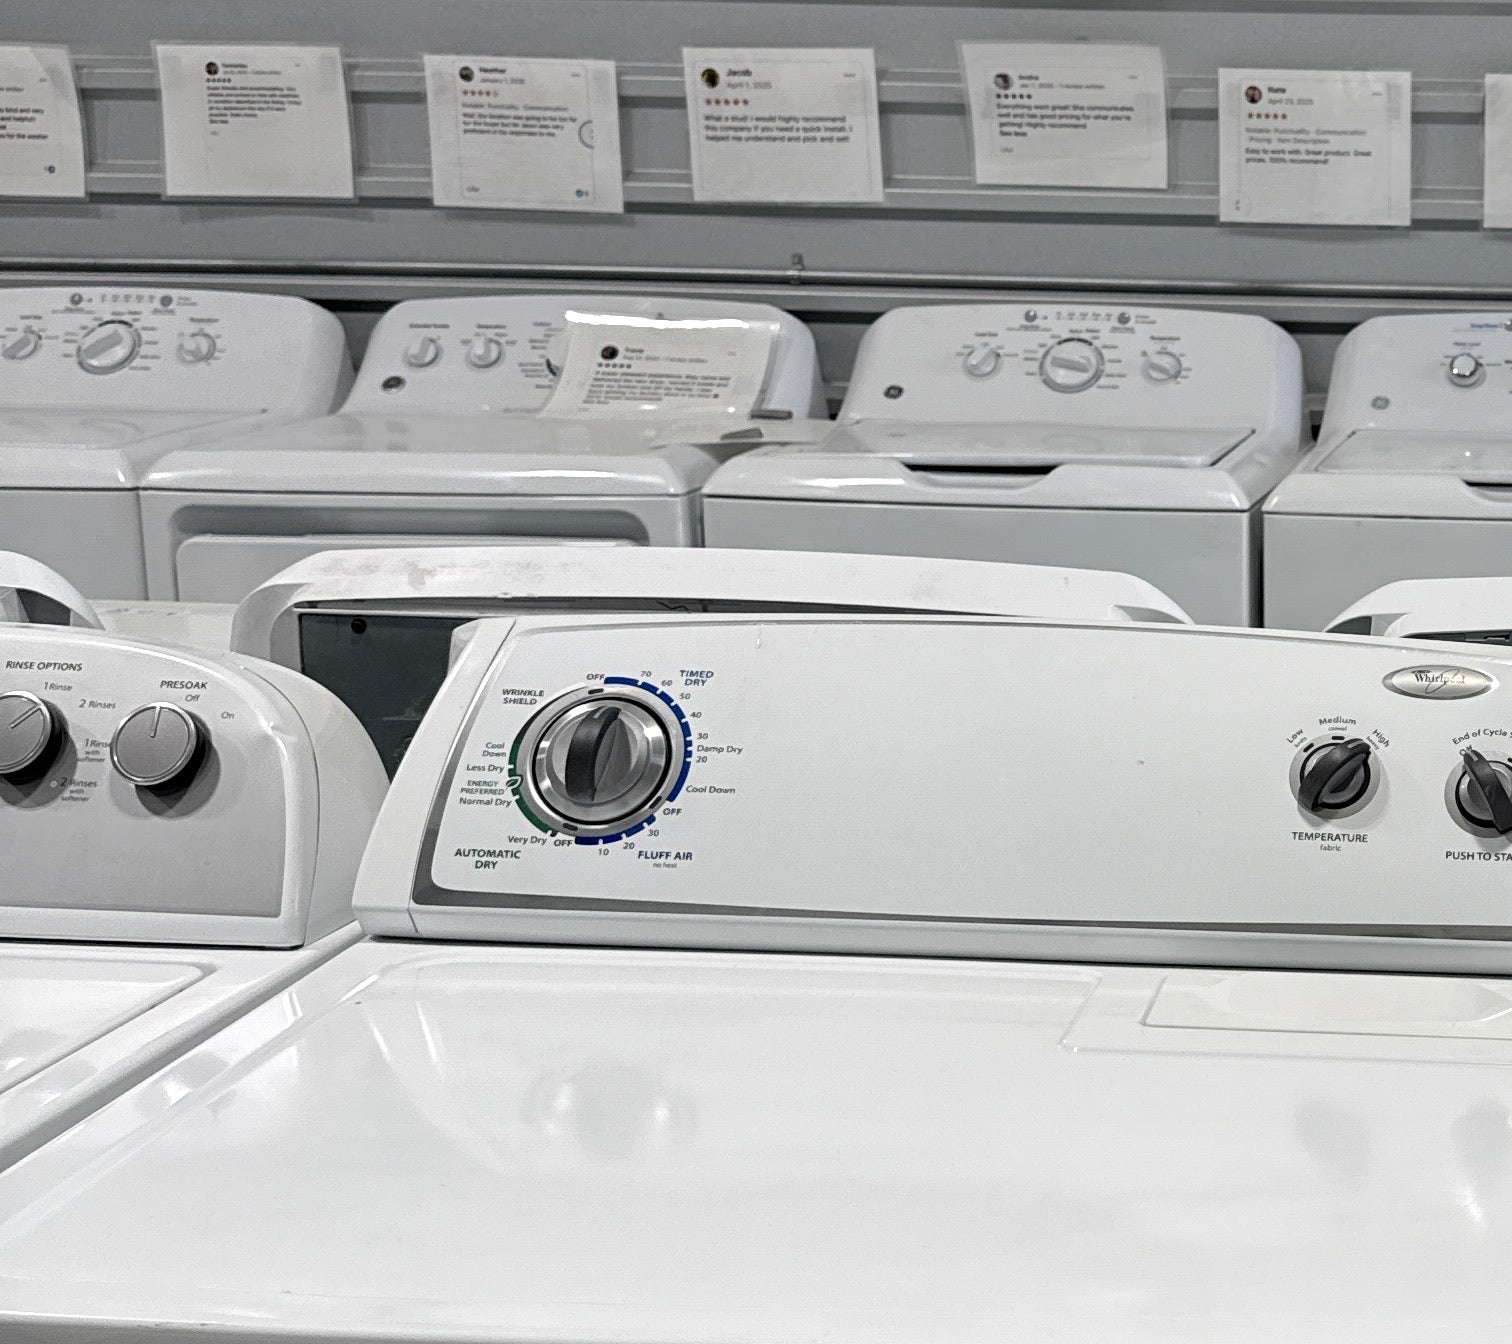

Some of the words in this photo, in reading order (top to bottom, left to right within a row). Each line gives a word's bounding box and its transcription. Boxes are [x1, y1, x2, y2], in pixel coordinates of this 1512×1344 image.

[6, 661, 35, 670] RINSE
[37, 662, 83, 671] OPTIONS
[680, 670, 714, 678] TIMED
[684, 679, 708, 687] DRY
[1414, 673, 1466, 685] Whirlpl
[49, 683, 72, 691] Rinse
[160, 680, 208, 689] PRESOAK
[502, 688, 544, 697] WRINKLE
[185, 694, 201, 702] Off
[503, 697, 537, 705] SHIELD
[79, 699, 86, 708] 2
[88, 700, 116, 709] Rinses
[221, 711, 235, 719] On
[1319, 716, 1357, 725] Medium
[1286, 728, 1304, 744] Low
[1372, 728, 1392, 748] High
[1452, 732, 1470, 745] End
[1472, 729, 1481, 737] of
[1483, 728, 1508, 737] Cycle
[696, 745, 724, 754] Damp
[726, 745, 743, 755] Dry
[488, 764, 505, 773] Dry
[60, 777, 67, 787] 2
[69, 779, 97, 788] Rinses
[686, 785, 706, 793] Cool
[709, 786, 736, 794] Down
[459, 797, 493, 805] Normal
[495, 798, 512, 808] Dry
[663, 808, 682, 816] OFF
[648, 829, 660, 837] 30
[1291, 832, 1369, 843] TEMPERATURE
[508, 836, 528, 845] Very
[530, 836, 548, 845] Dry
[554, 839, 573, 847] OFF
[623, 842, 635, 850] 20
[1319, 843, 1342, 852] fabric
[454, 848, 522, 859] AUTOMATIC
[598, 848, 609, 856] 10
[637, 850, 672, 860] FLUFF
[674, 851, 693, 861] AIR
[1445, 851, 1476, 862] PUSH
[1477, 851, 1492, 862] TO
[474, 860, 498, 869] DRY
